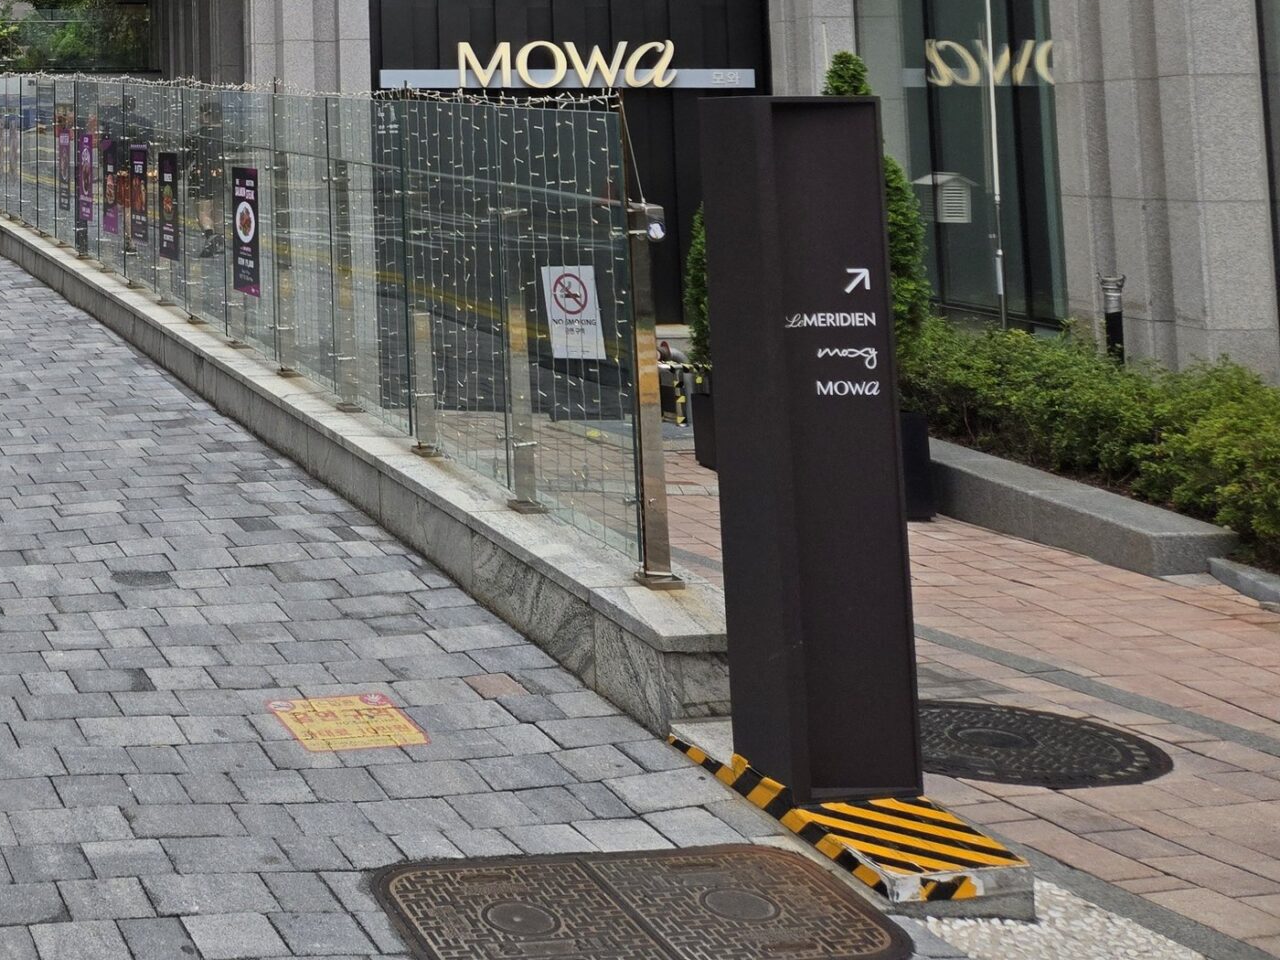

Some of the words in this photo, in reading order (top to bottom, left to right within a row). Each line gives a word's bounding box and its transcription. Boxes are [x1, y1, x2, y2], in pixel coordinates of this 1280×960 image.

[712, 71, 739, 84] 모와
[565, 318, 597, 326] SMOKING
[785, 313, 804, 328] Le
[803, 312, 876, 327] MERIDIEN
[817, 348, 878, 369] moxy
